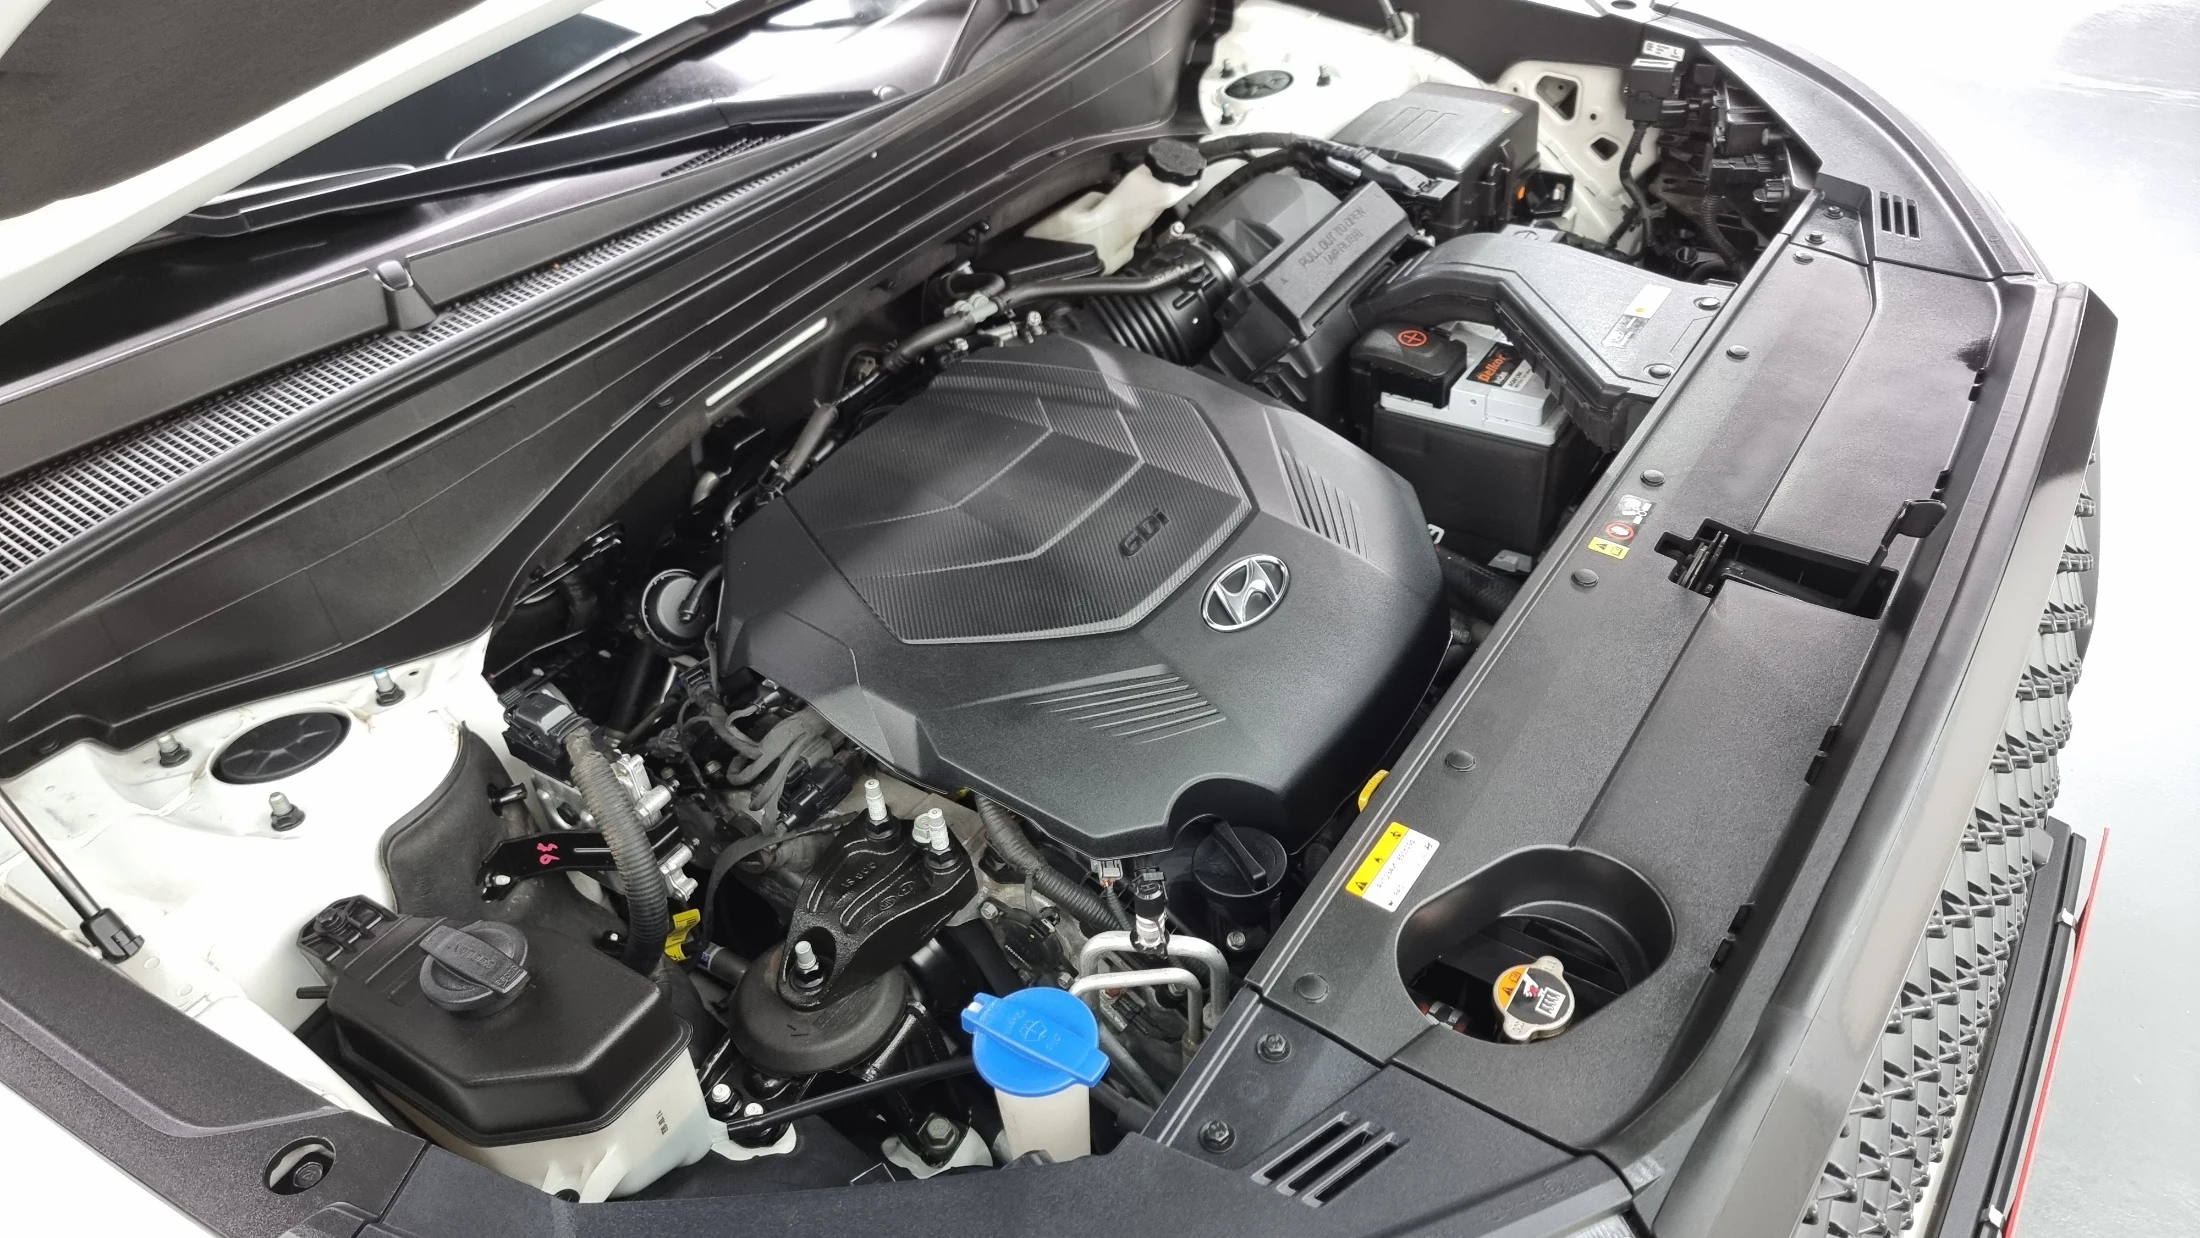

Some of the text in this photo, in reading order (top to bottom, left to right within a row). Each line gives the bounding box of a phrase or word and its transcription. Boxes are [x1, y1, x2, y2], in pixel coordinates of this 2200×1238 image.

[1298, 206, 1367, 269] PULL OUT TO OPEN
[1477, 352, 1508, 383] Delkor
